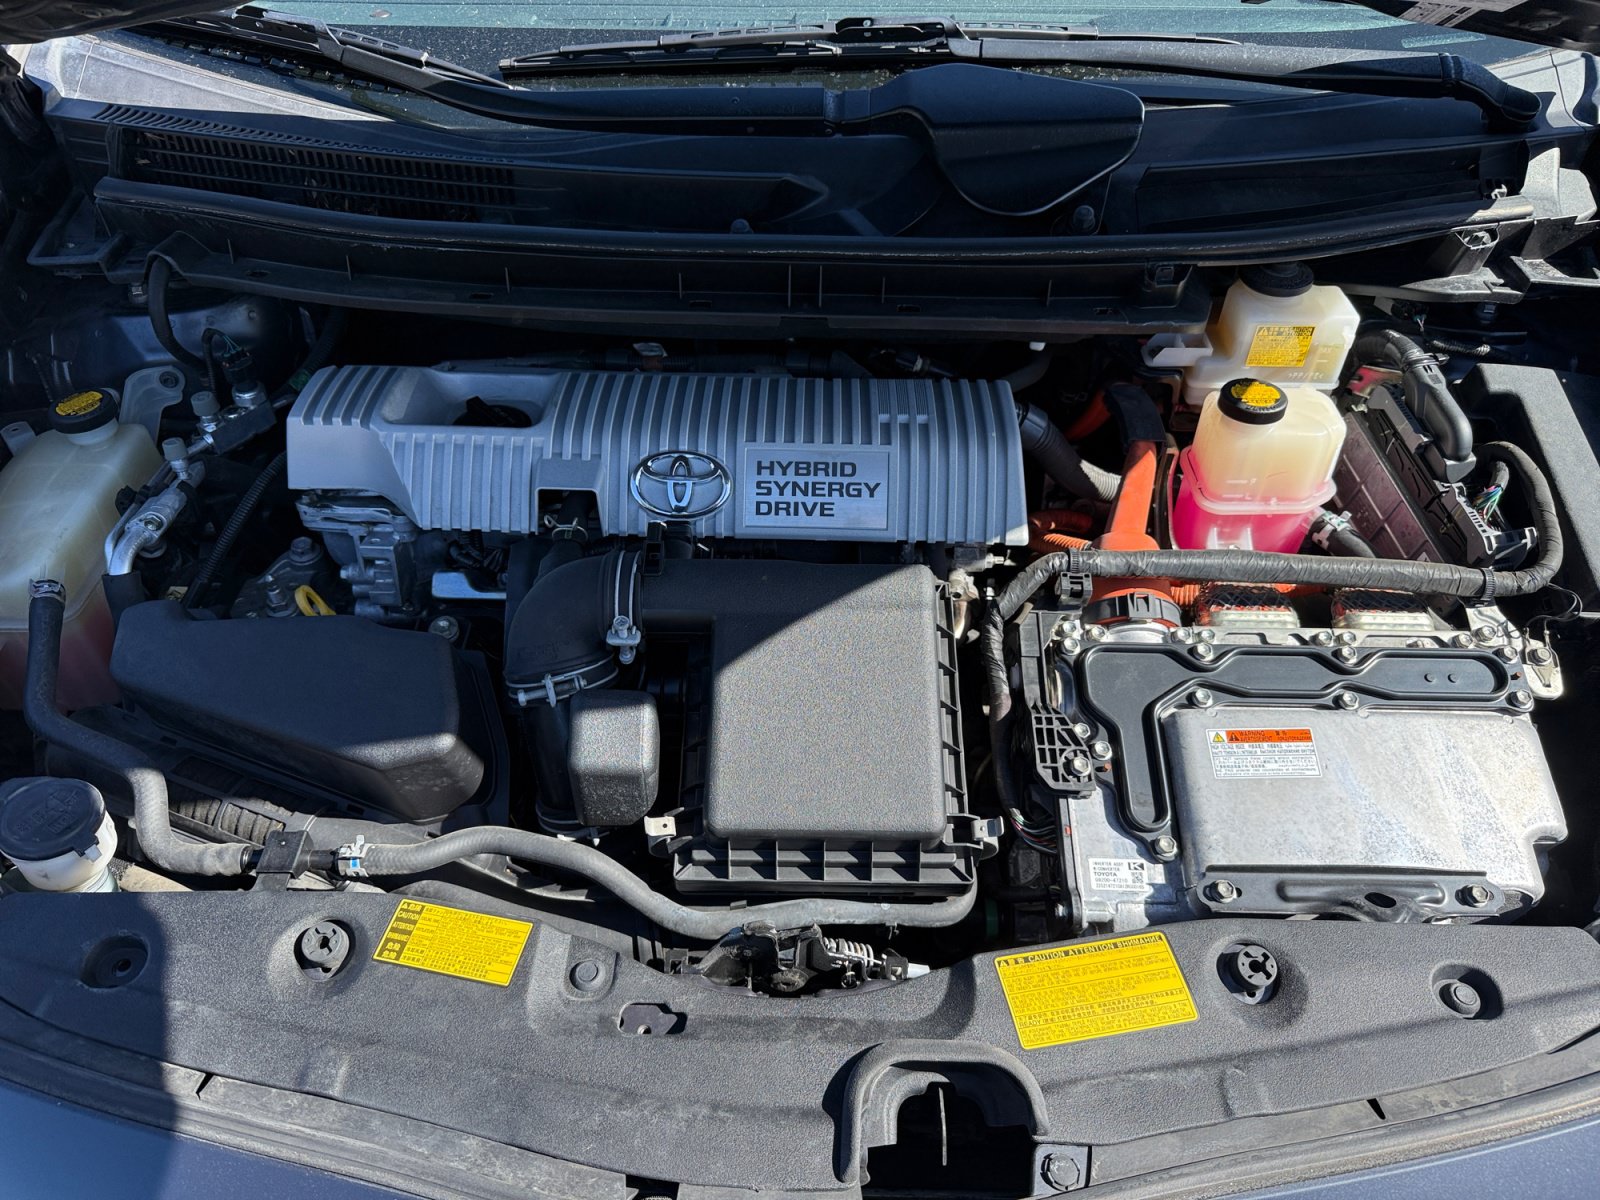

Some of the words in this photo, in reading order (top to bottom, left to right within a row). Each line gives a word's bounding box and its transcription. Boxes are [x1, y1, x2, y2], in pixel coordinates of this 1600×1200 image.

[757, 461, 857, 477] HYBRID
[755, 481, 881, 498] SYNERGY
[755, 501, 835, 517] DRIVE
[397, 910, 420, 920] CAUTION
[392, 921, 415, 931] ATTENTION
[1028, 951, 1065, 963] CAUTION
[1068, 942, 1115, 957] ATTENTION
[1117, 935, 1162, 949] ВНИМАНИЕ
